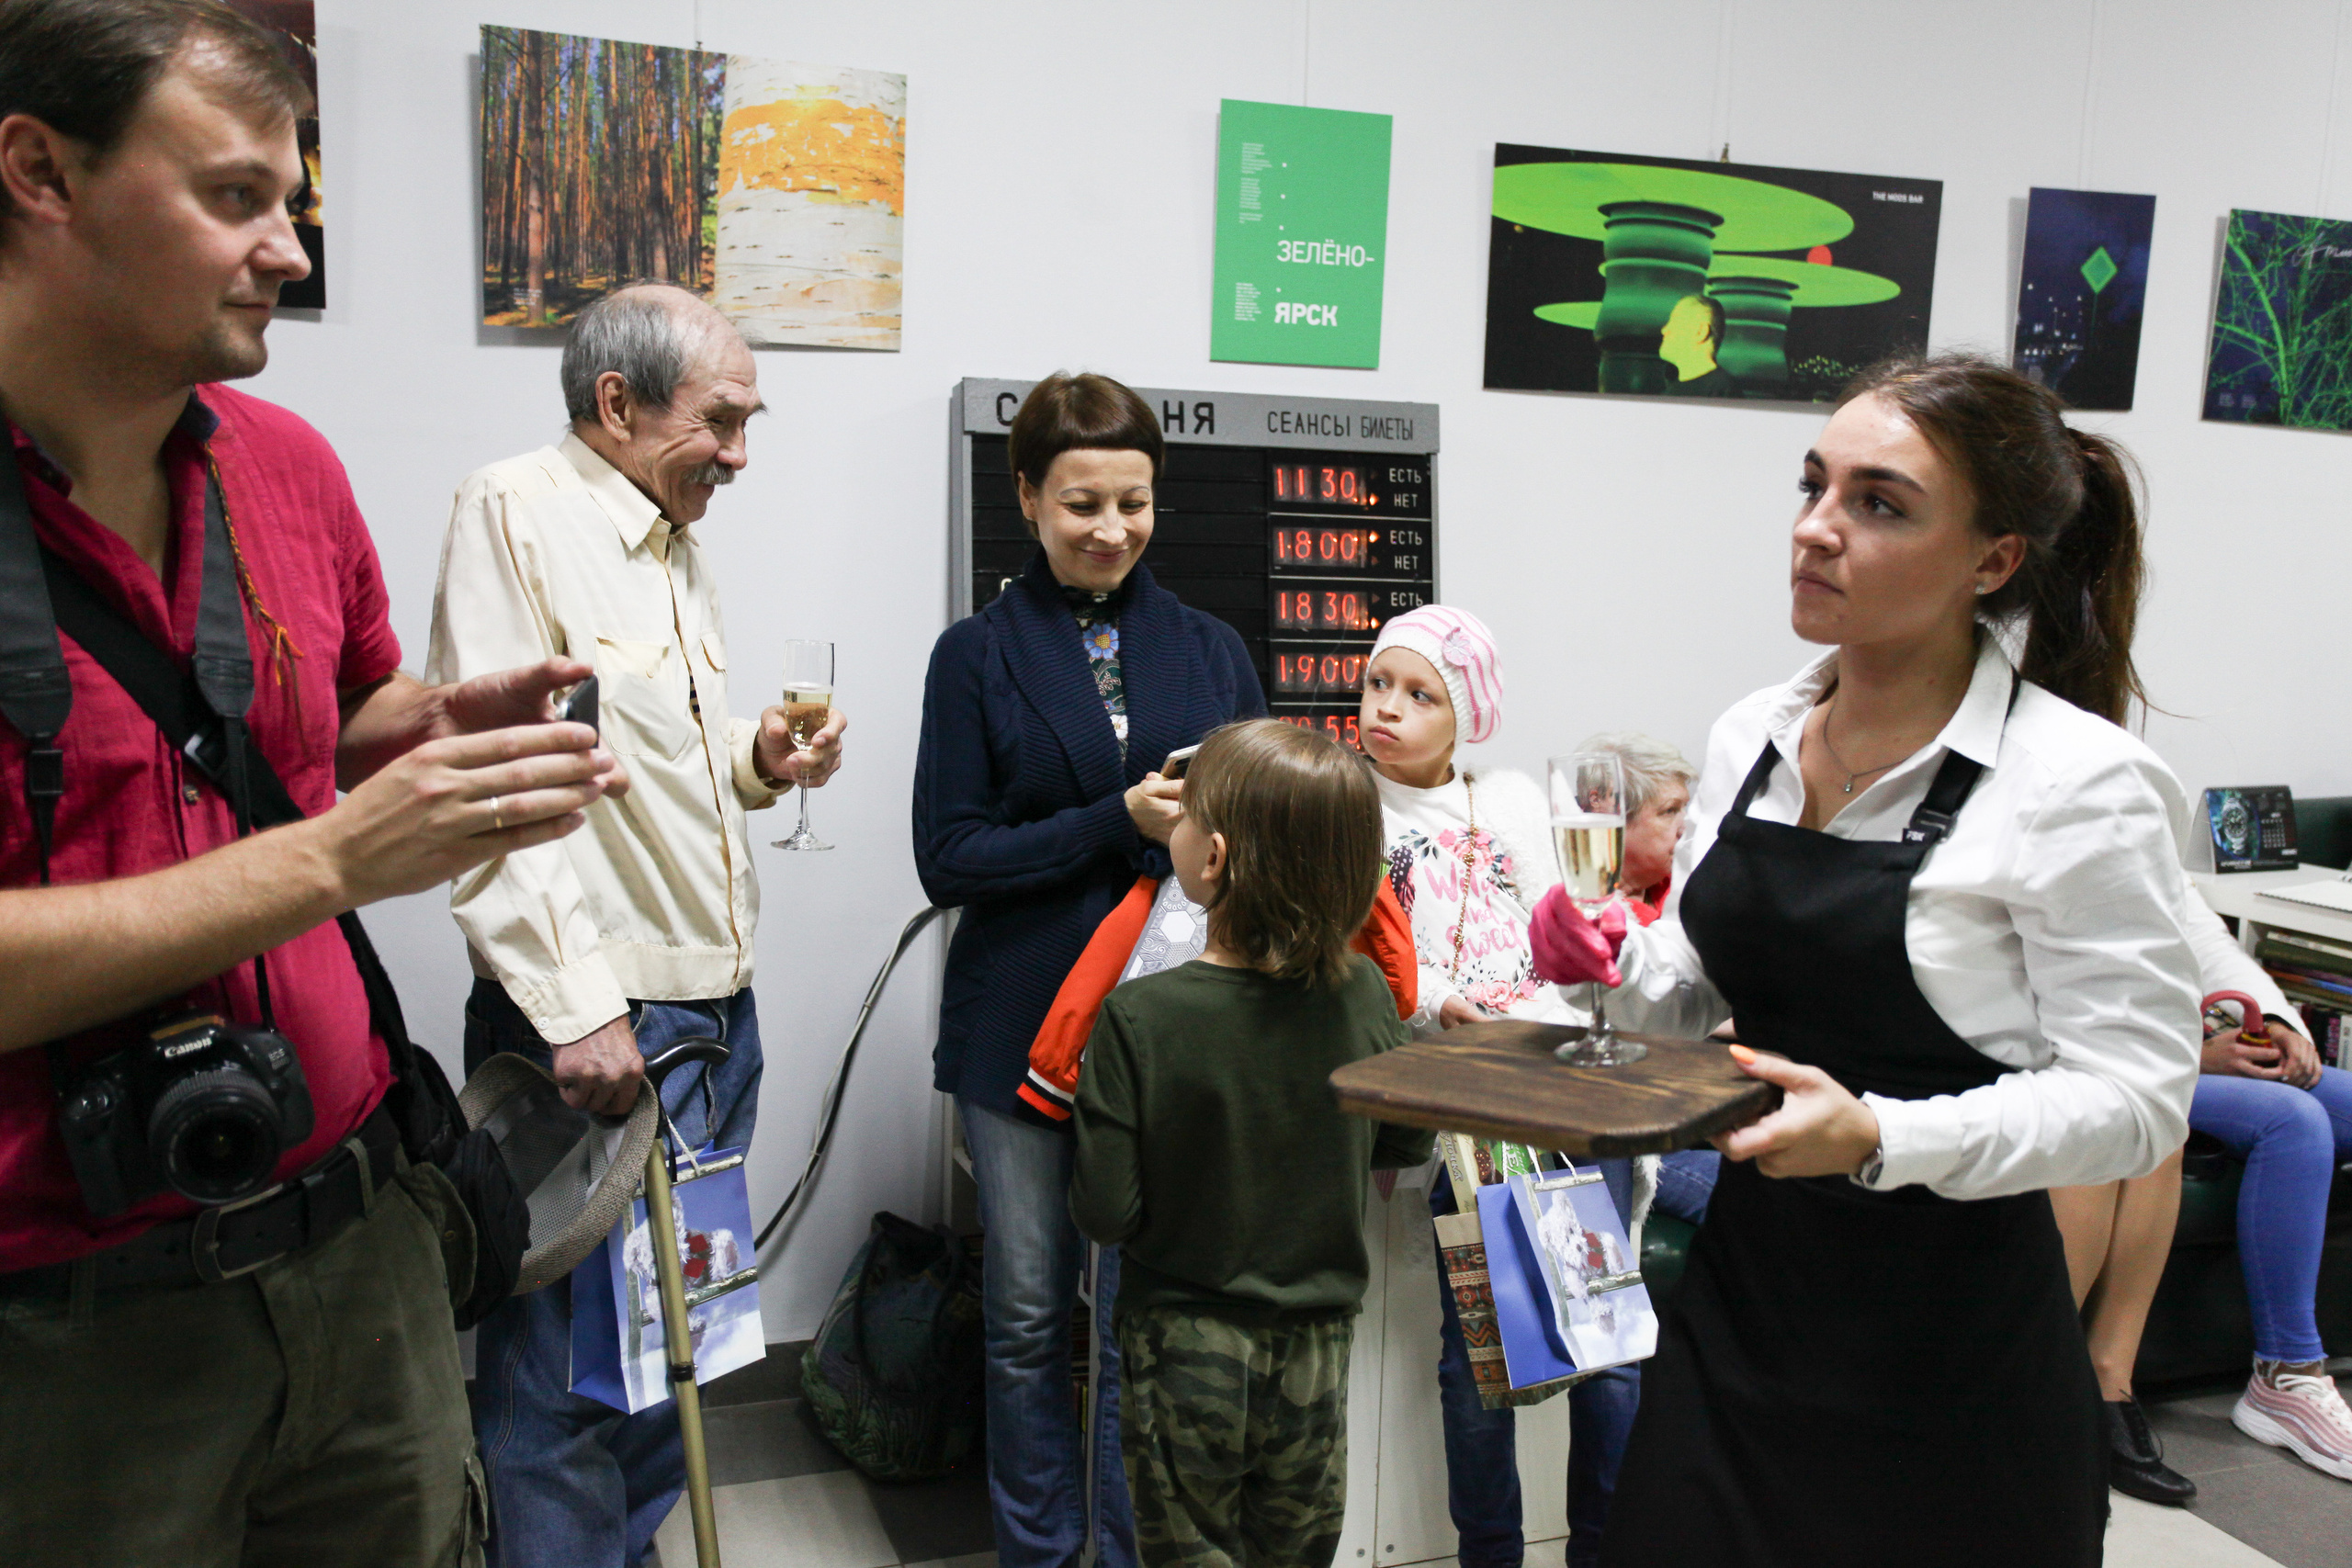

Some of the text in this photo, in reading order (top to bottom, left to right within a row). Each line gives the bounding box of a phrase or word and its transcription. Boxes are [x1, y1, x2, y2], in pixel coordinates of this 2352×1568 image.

[1908, 194, 1924, 204] BAR
[1276, 238, 1374, 267] ЗЕЛЁНО-
[1274, 301, 1338, 326] ЯРСК
[1268, 411, 1414, 441] СЕАНСЫ БИЛЕТЫ
[1389, 468, 1422, 483] ЕСТЬ
[1394, 493, 1418, 508] НЕТ
[1390, 530, 1423, 545] ЕСТЬ
[1395, 555, 1419, 570] НЕТ
[1390, 592, 1423, 607] ЕСТЬ
[164, 1037, 213, 1059] Canon
[1439, 1131, 1464, 1182] ЕЛОЧКА
